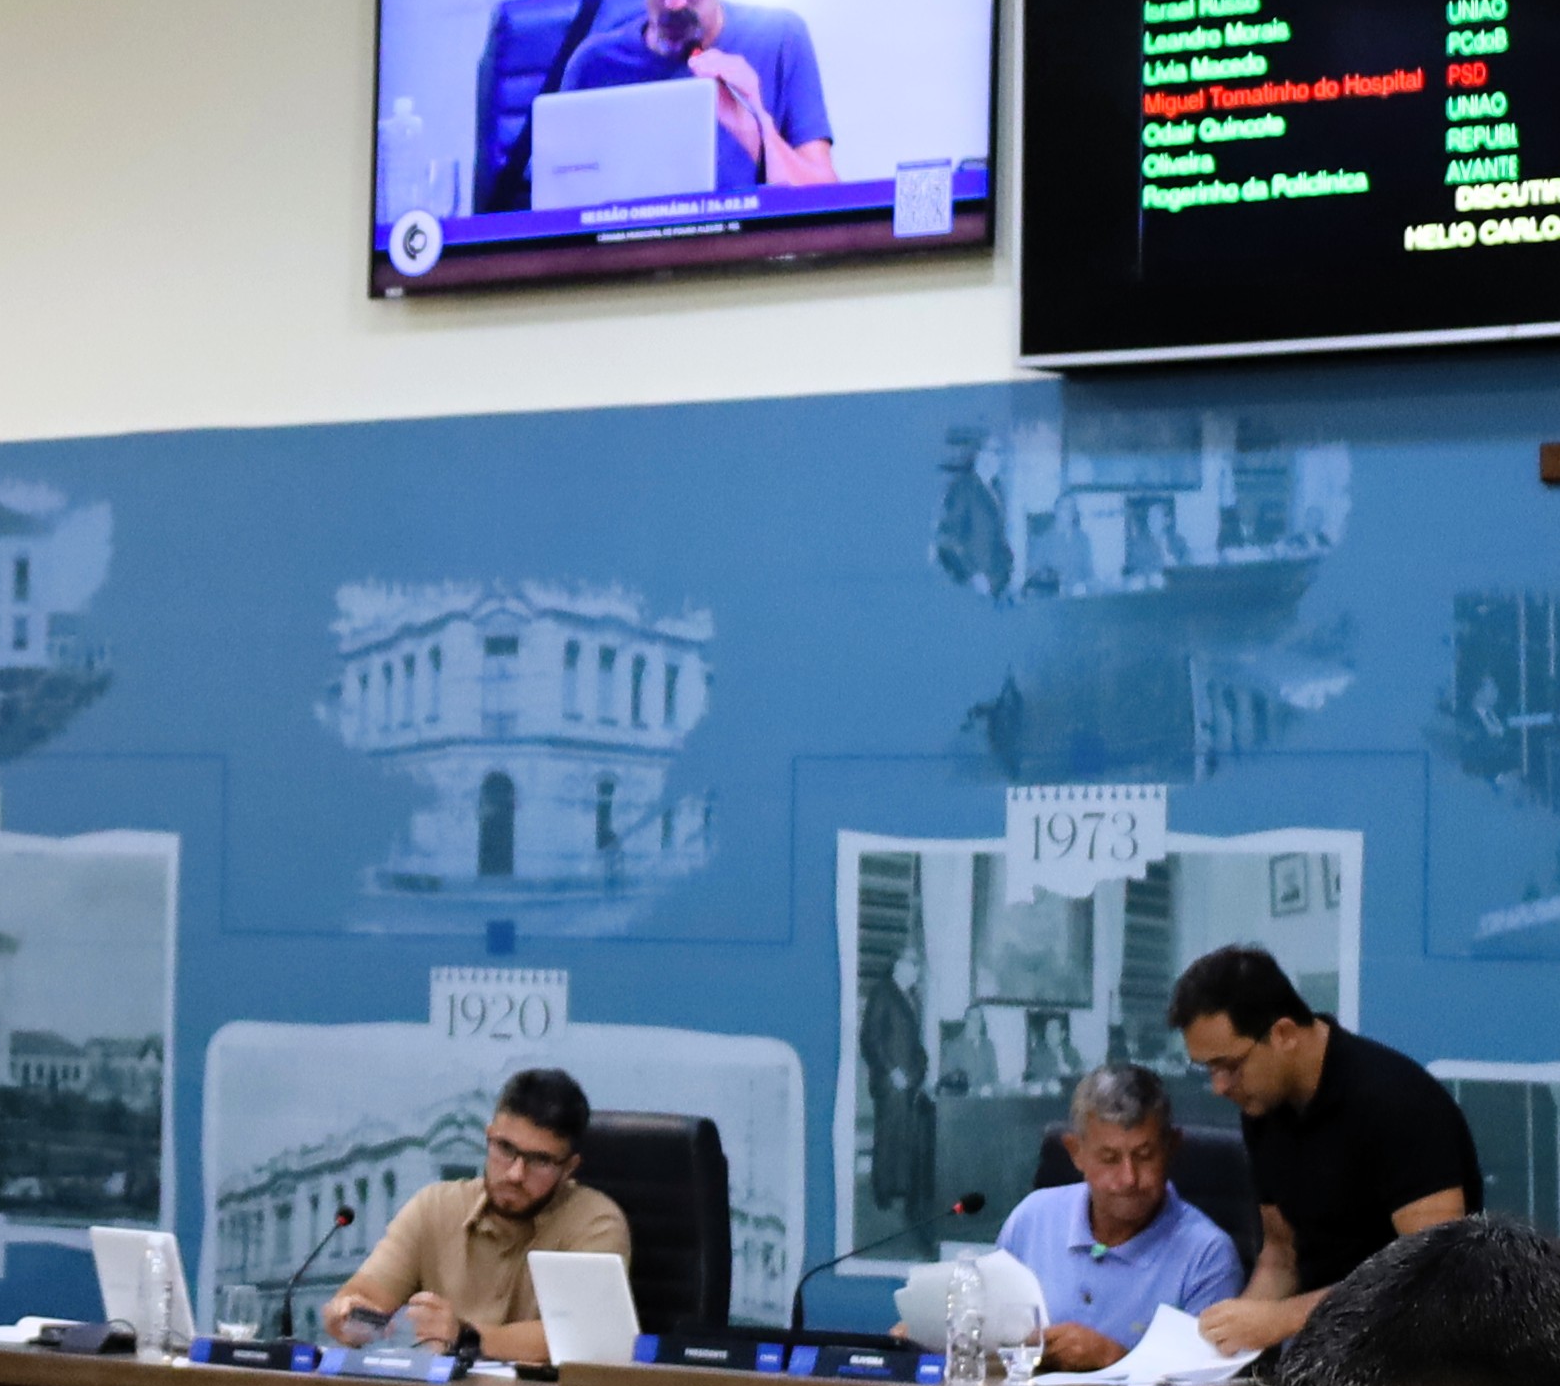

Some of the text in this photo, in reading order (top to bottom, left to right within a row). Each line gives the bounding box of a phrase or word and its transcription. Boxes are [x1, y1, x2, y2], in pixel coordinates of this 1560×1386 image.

[1143, 16, 1291, 55] Leandro Morais
[1446, 26, 1509, 57] PCdoB
[1190, 50, 1268, 81] Macedo
[1446, 60, 1489, 89] PSD
[1142, 66, 1425, 118] Miguel Tomatinho do Hospital
[1142, 112, 1287, 147] Odair Quincote
[1142, 150, 1216, 179] Oliveira
[1444, 154, 1520, 185] AVANTE
[1142, 179, 1240, 213] Rogerinho
[1241, 176, 1270, 202] da
[1403, 220, 1477, 251] HELIO
[1030, 812, 1140, 863] 1973
[442, 992, 553, 1041] 1920
